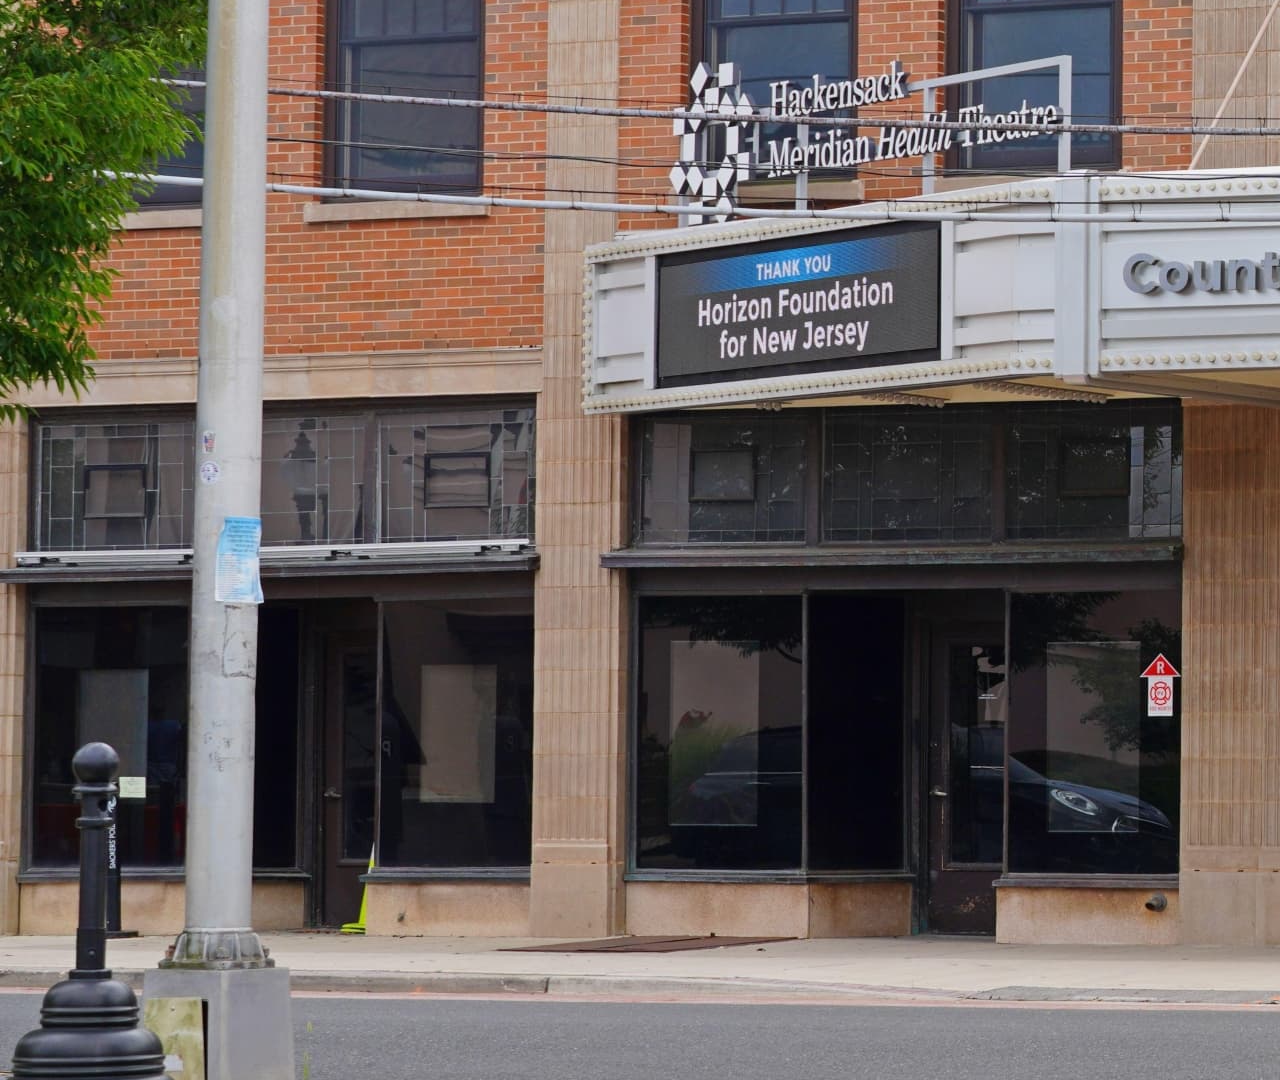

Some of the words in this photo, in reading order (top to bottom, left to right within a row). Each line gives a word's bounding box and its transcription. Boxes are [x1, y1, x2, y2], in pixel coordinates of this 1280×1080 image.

[769, 60, 907, 119] Hackensack
[767, 129, 871, 179] Meridian
[873, 109, 952, 161] Health
[958, 99, 1058, 148] Theatre
[756, 258, 800, 282] THANK
[803, 253, 832, 275] YOU
[697, 293, 773, 328] Horizon
[777, 277, 894, 318] Foundation
[719, 329, 747, 360] for
[752, 325, 798, 356] New
[802, 320, 870, 352] Jersey
[1156, 661, 1165, 674] R
